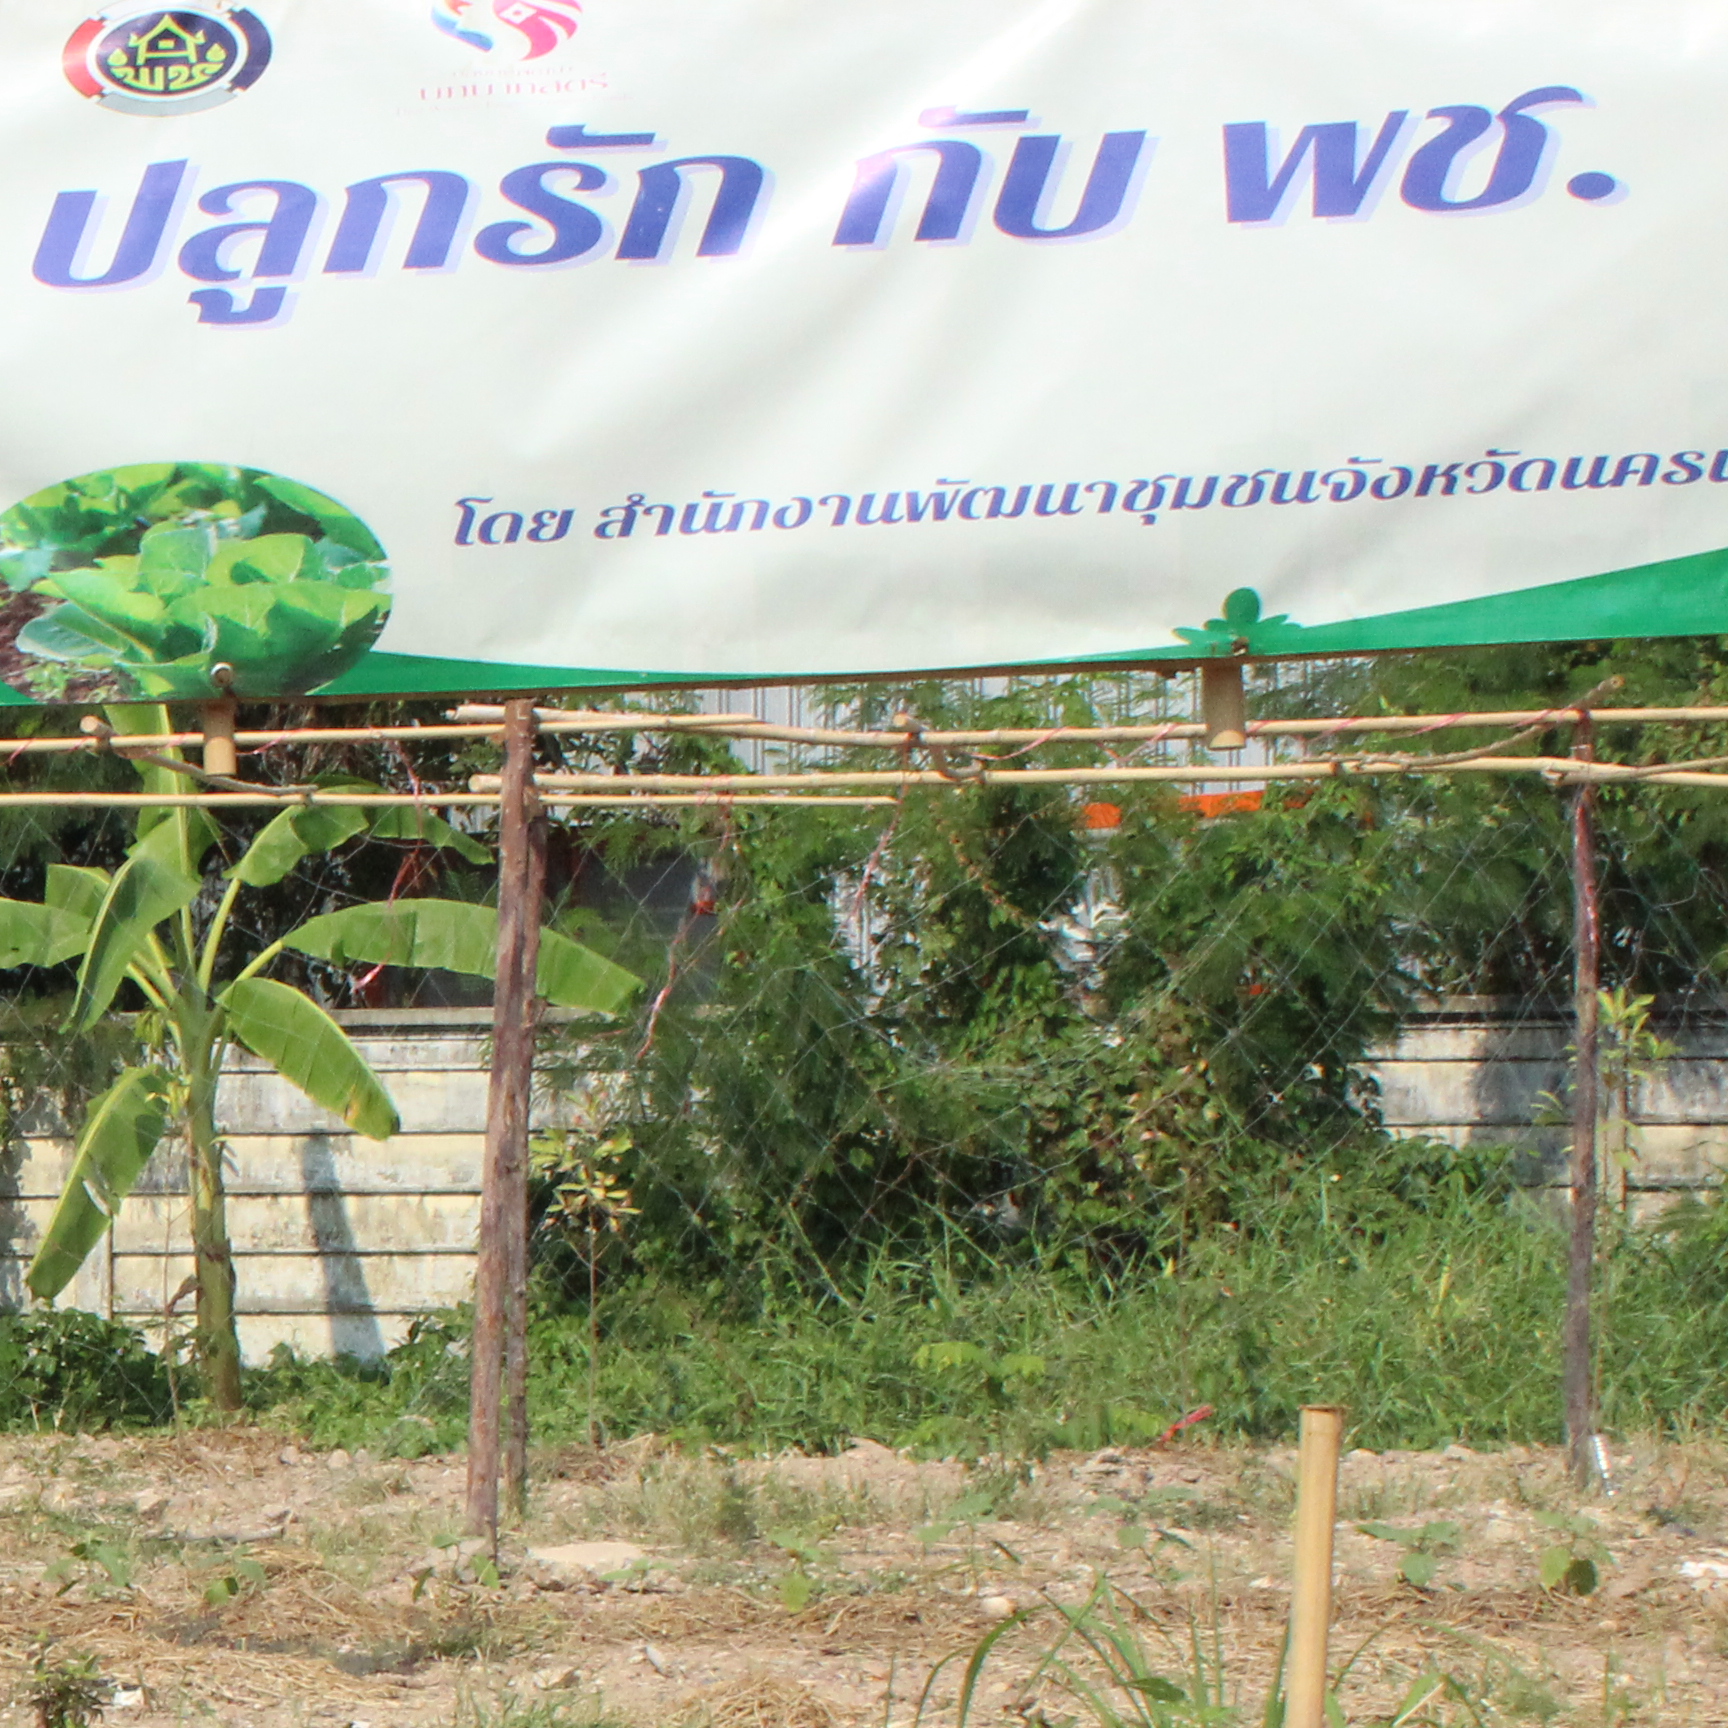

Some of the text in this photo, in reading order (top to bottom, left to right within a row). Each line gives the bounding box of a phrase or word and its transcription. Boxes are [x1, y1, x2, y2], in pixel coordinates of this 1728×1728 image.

[32, 123, 776, 328] ปลูกรัก
[832, 105, 1156, 250] กับ
[1222, 84, 1630, 226] พช.
[454, 496, 576, 546] โดย
